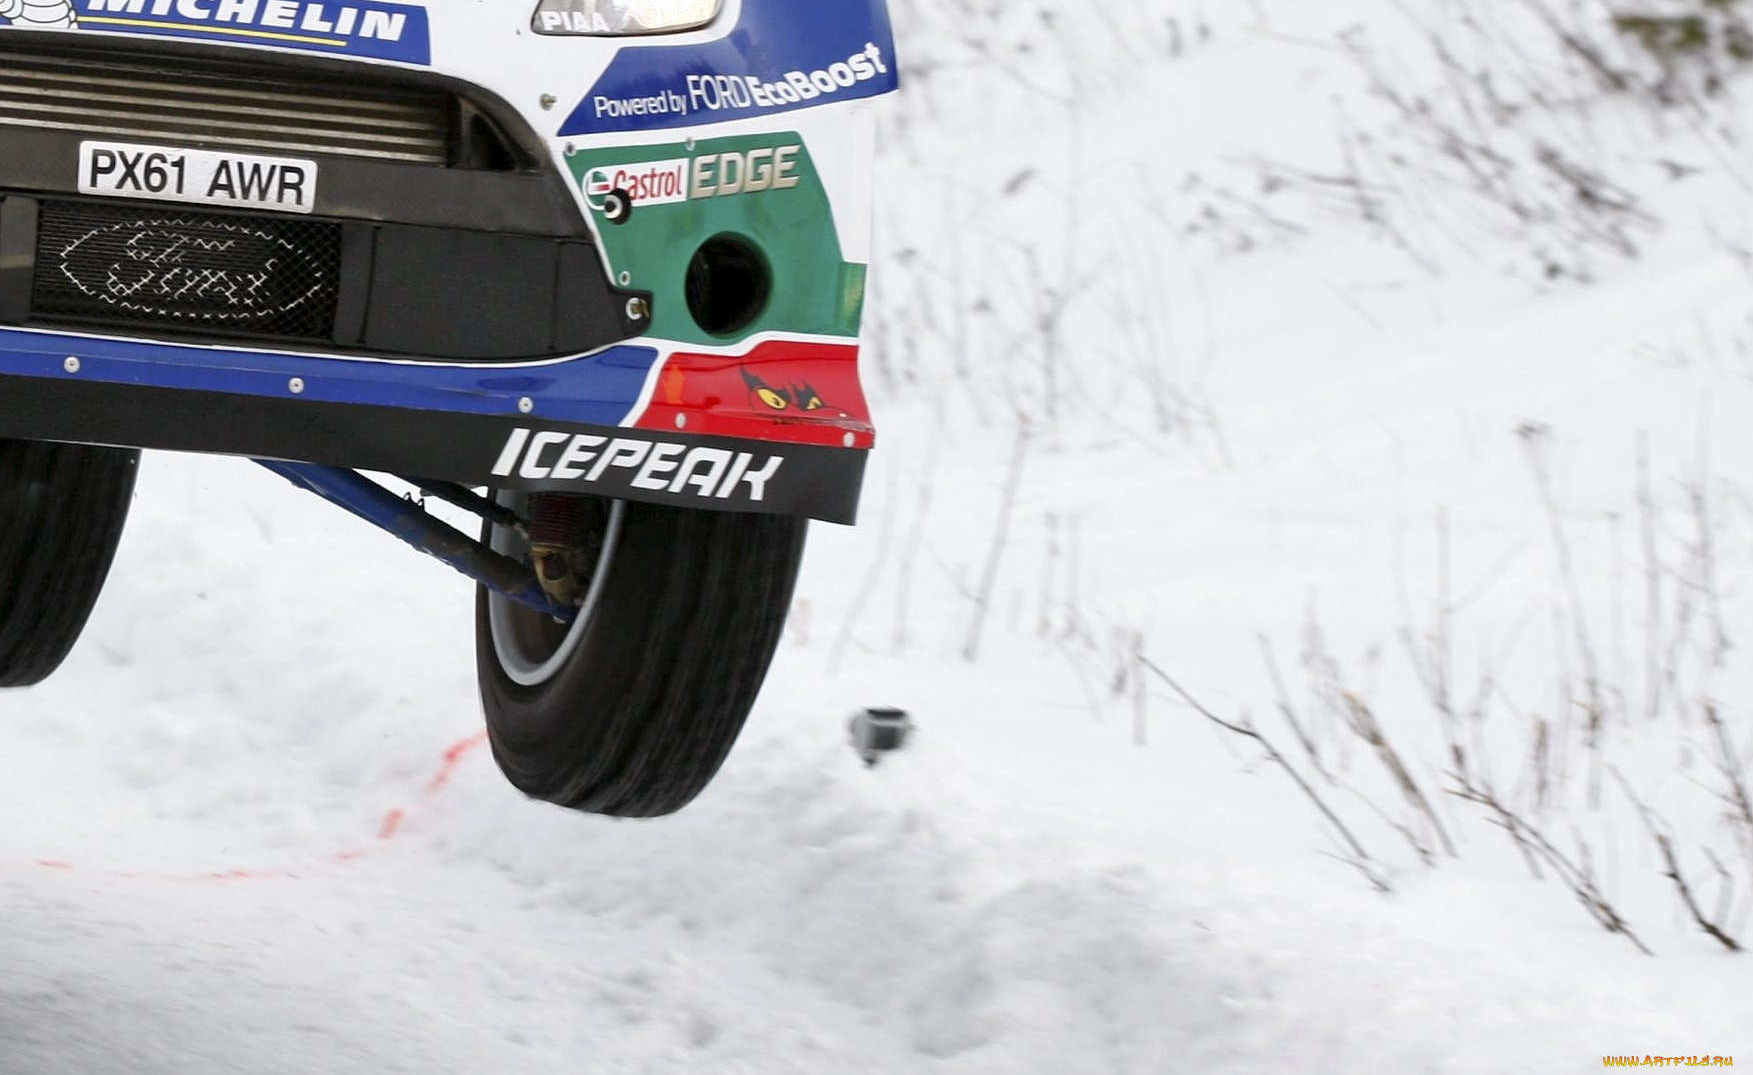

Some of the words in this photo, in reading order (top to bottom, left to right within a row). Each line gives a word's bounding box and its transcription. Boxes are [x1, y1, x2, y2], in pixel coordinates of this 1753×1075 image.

[541, 10, 610, 33] PIAA
[594, 90, 667, 119] Powered
[666, 89, 687, 116] by
[687, 74, 750, 111] FORD
[747, 42, 888, 108] EcoBoost
[90, 148, 187, 195] PX61
[206, 158, 307, 206] AWR
[613, 164, 683, 201] Castrol
[689, 144, 802, 200] EDGE
[491, 427, 785, 501] ICEPEAK
